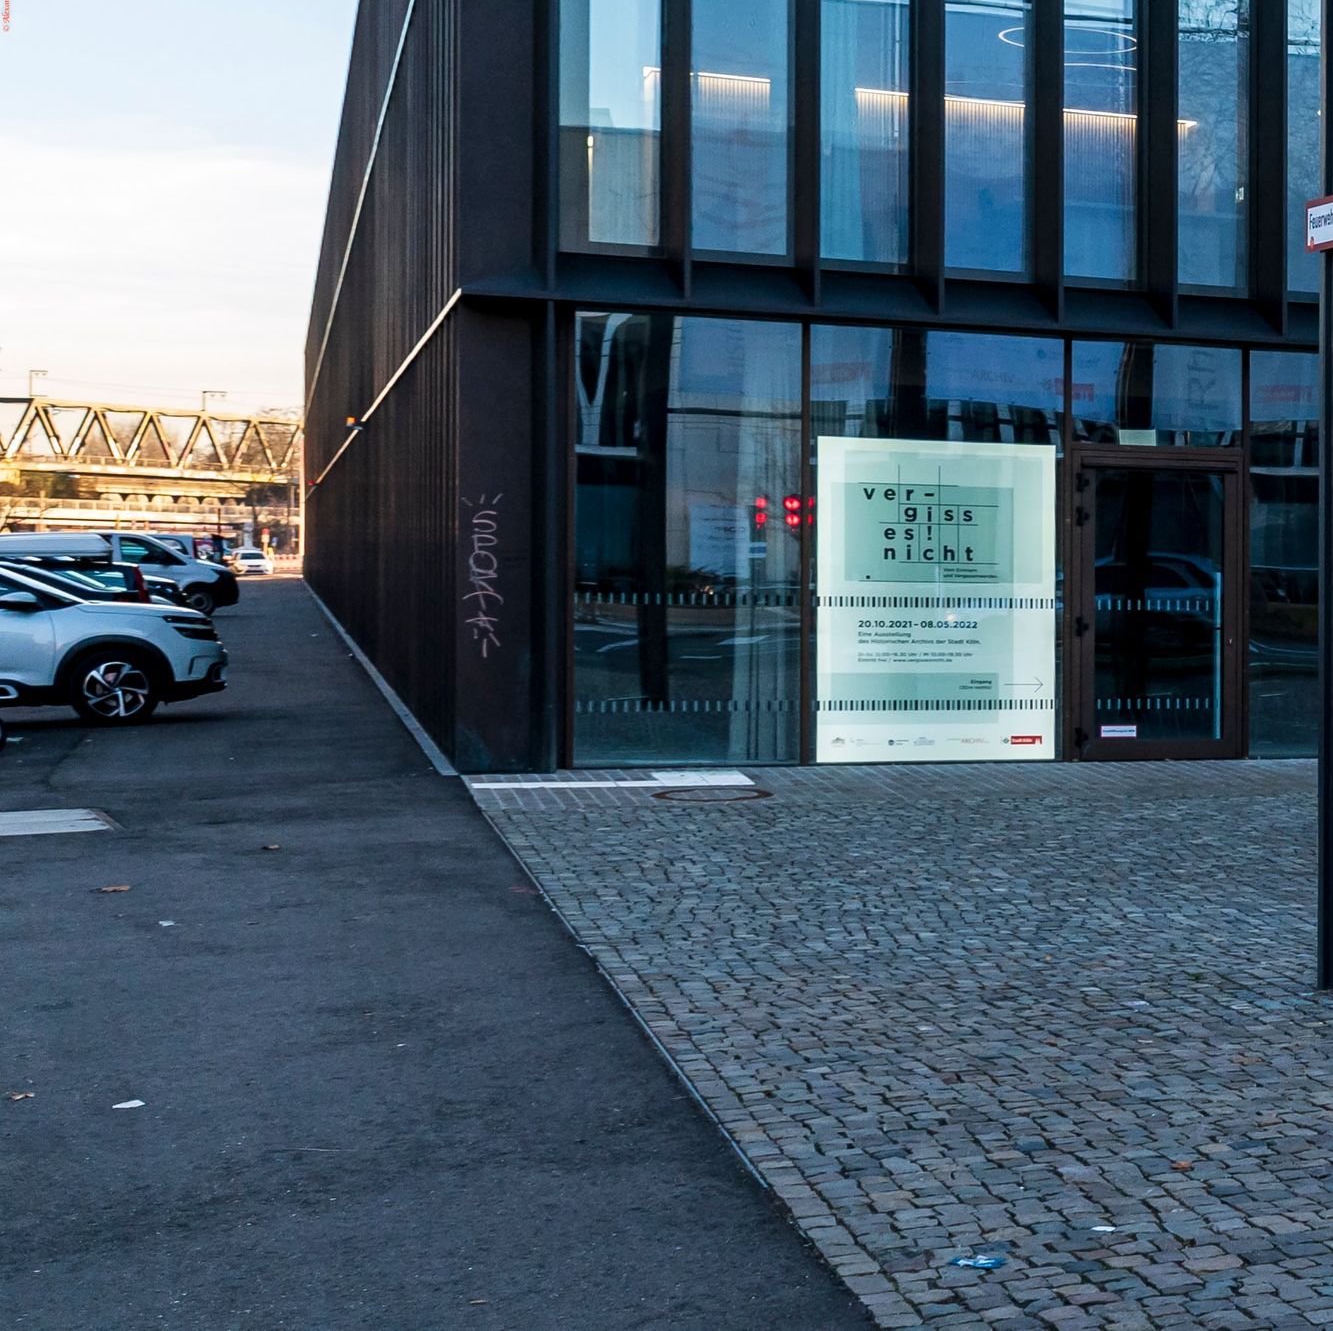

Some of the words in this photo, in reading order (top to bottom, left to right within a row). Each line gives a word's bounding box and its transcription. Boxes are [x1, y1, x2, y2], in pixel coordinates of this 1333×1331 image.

[904, 506, 973, 523] giss
[884, 525, 932, 541] es!
[884, 544, 974, 561] nicht
